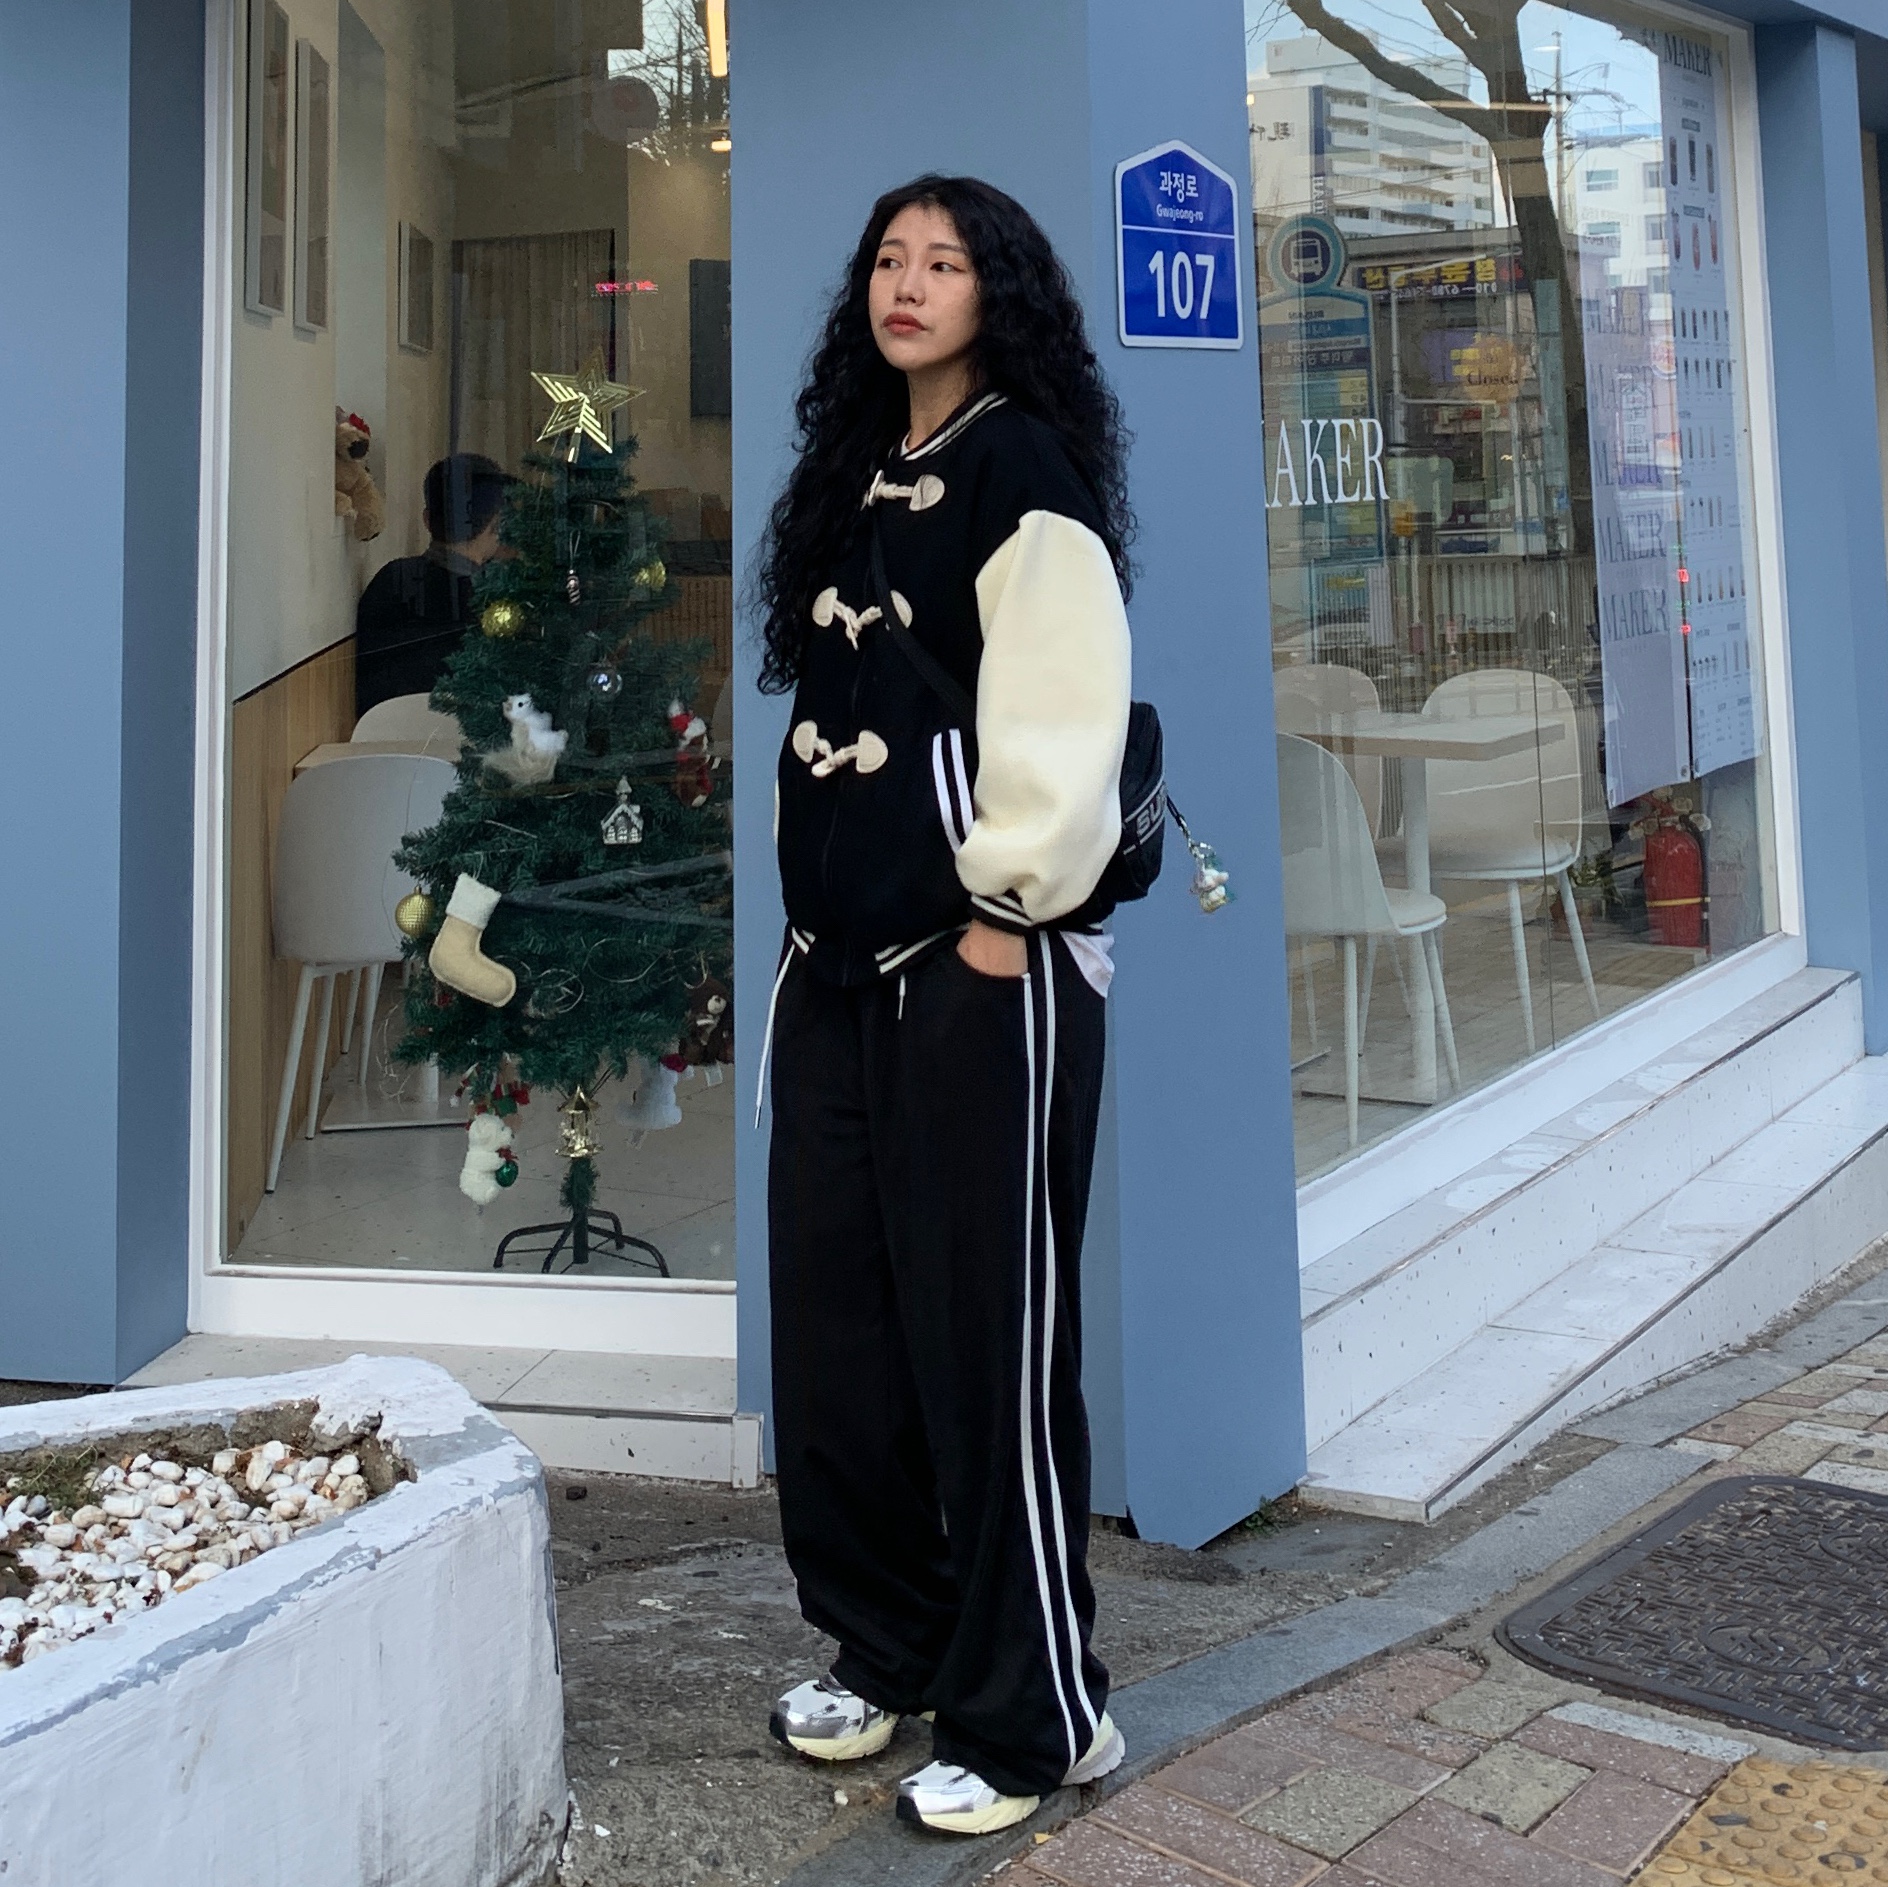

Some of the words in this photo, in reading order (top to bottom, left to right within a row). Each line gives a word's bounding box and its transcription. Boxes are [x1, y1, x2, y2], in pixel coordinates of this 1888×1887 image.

[1664, 32, 1713, 77] MAKER
[1159, 171, 1199, 203] 과정로
[1156, 203, 1204, 223] Gwajeong-ro
[1148, 250, 1215, 320] 107
[1261, 418, 1390, 508] AKER
[1602, 588, 1670, 645] MAKER
